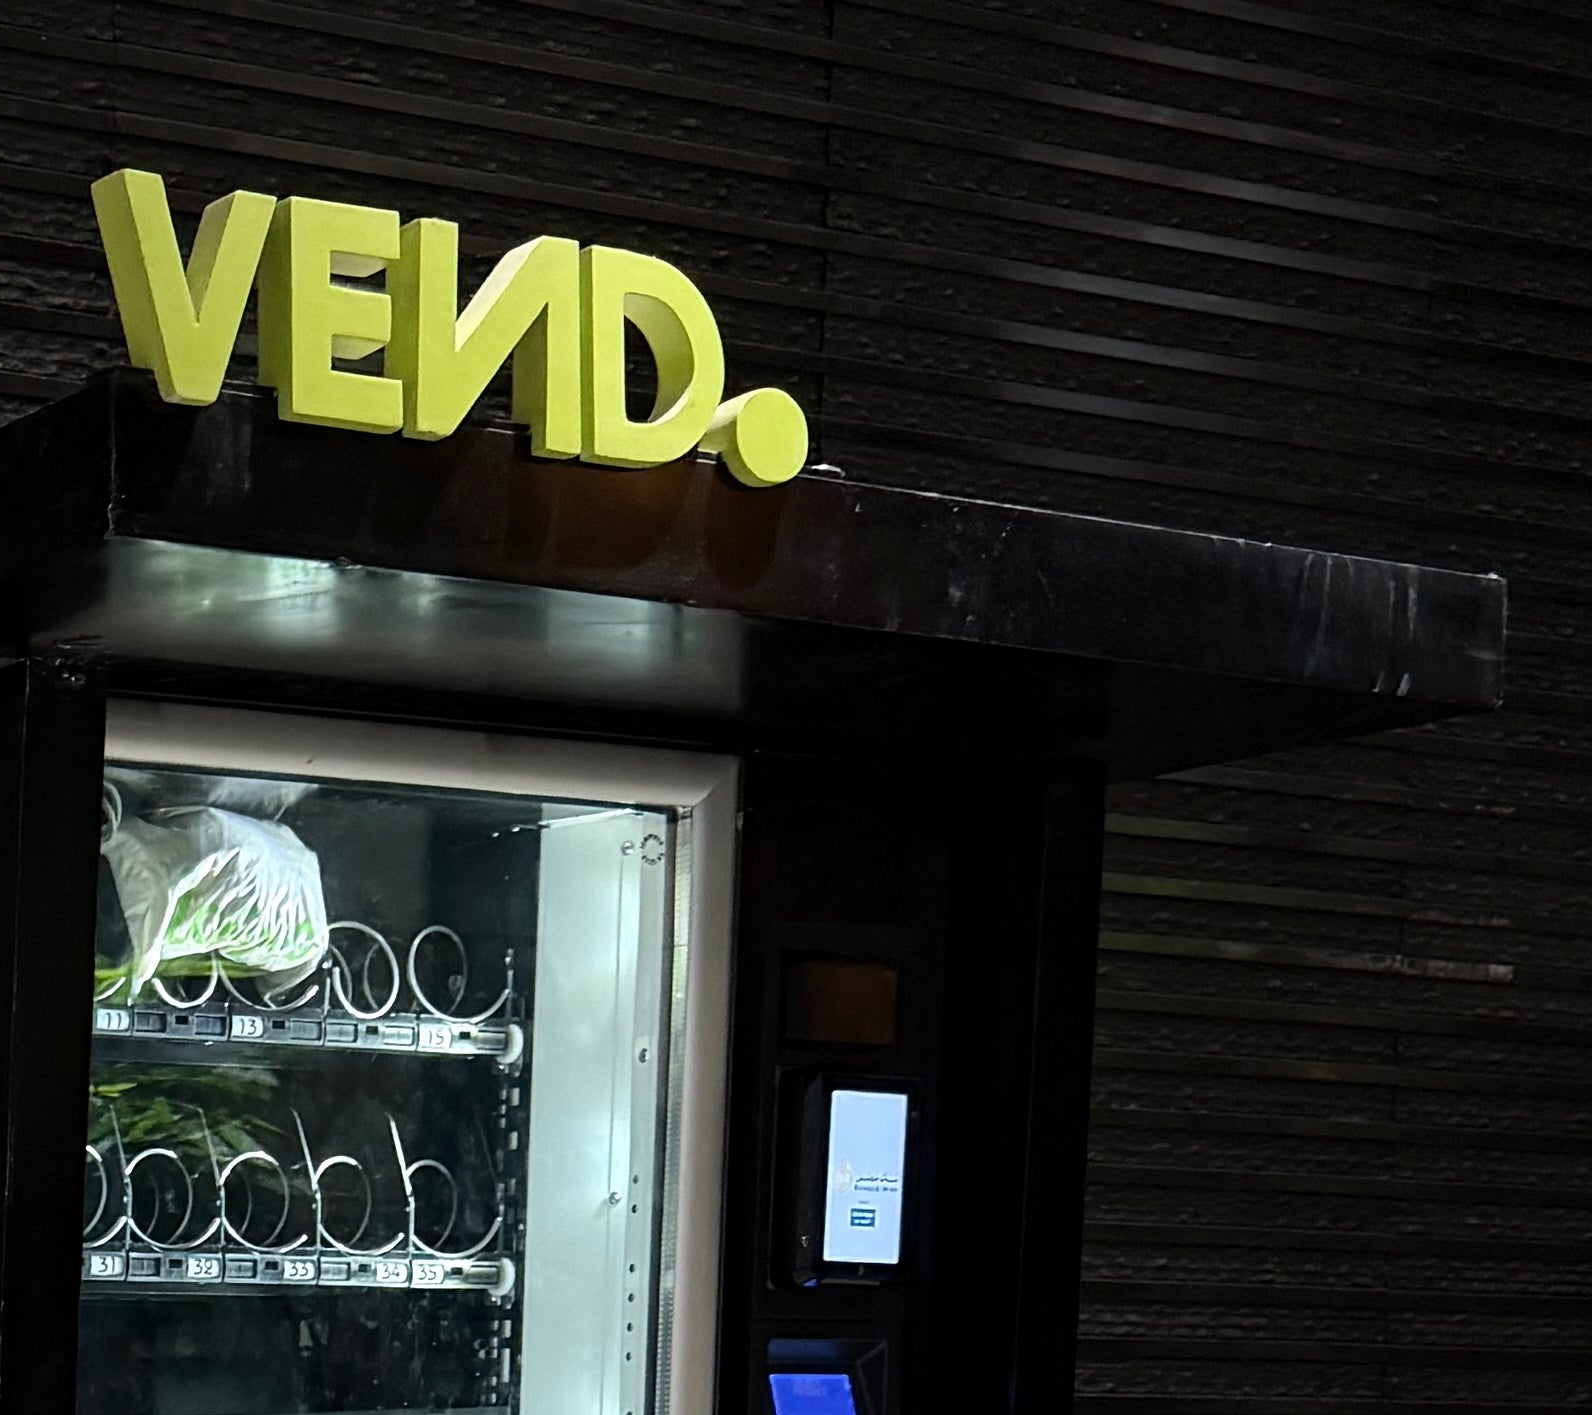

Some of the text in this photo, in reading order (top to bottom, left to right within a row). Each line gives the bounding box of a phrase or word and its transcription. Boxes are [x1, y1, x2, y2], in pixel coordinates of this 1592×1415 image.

[104, 1012, 446, 1045] 11 13 15
[97, 1257, 437, 1280] 31 32 33 34 35
